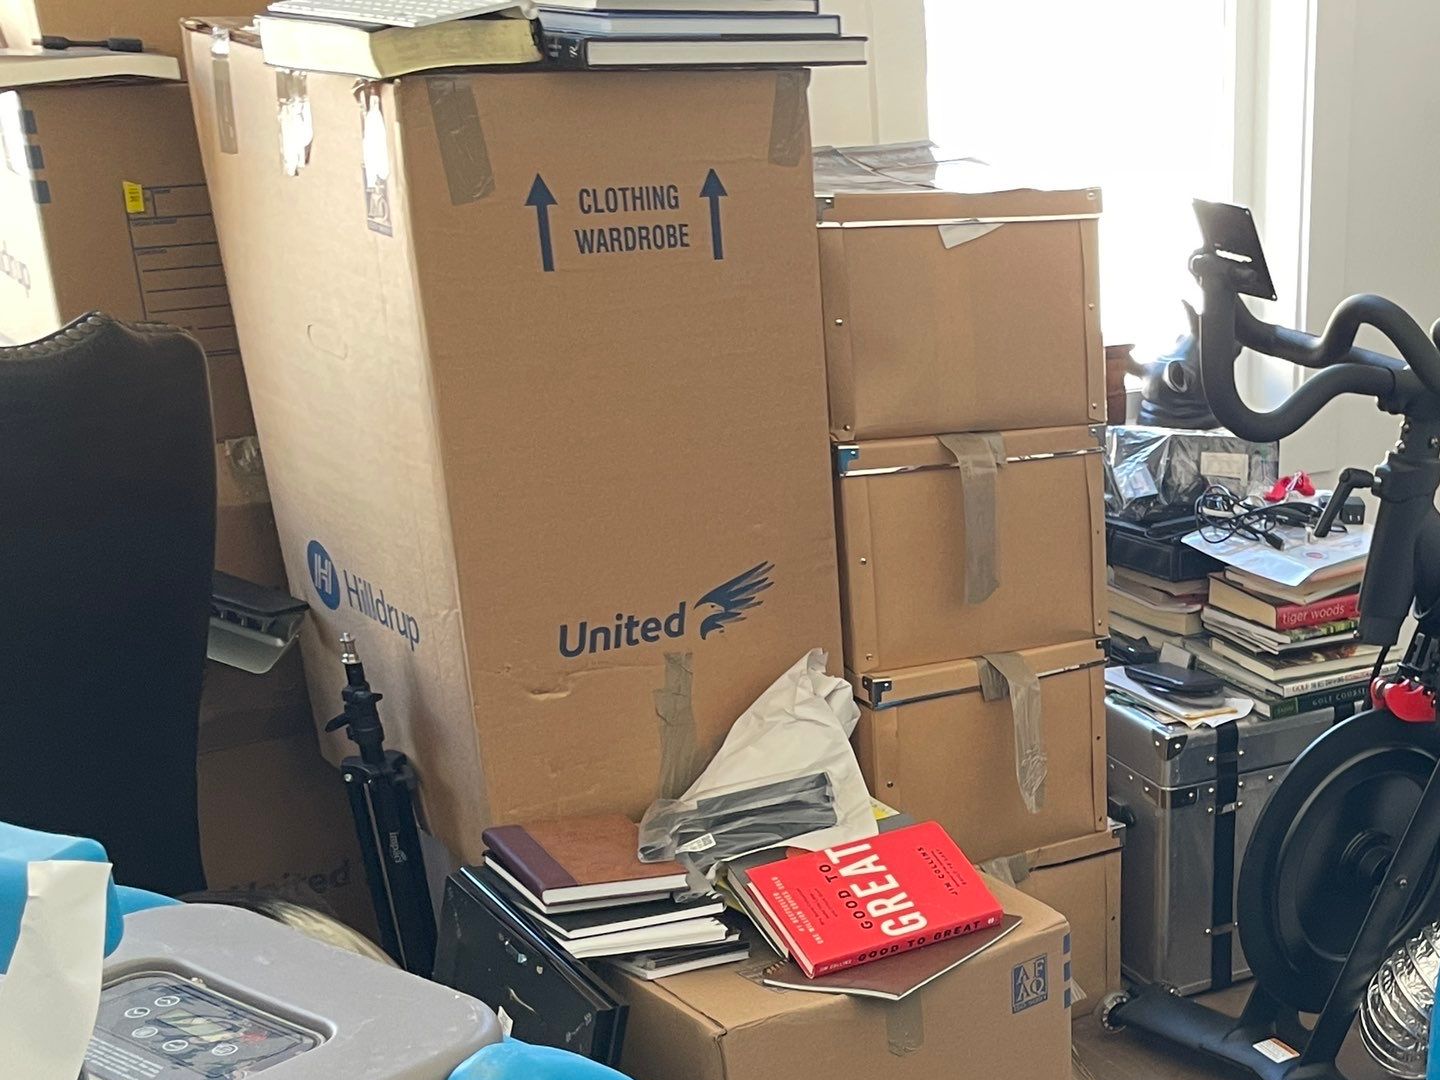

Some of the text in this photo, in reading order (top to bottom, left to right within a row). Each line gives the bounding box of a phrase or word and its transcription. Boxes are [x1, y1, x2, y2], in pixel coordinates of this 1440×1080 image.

[578, 184, 680, 215] CLOTHING
[574, 224, 690, 254] WARDROBE
[343, 568, 420, 652] Hilldrup
[1281, 603, 1345, 625] tiger woods
[558, 601, 687, 658] United
[819, 864, 838, 883] TO
[916, 846, 945, 879] COLLINS
[824, 843, 928, 937] GREAT
[943, 882, 958, 896] JIM
[838, 890, 873, 929] GOOD
[858, 920, 981, 962] GOOD TO GREAT
